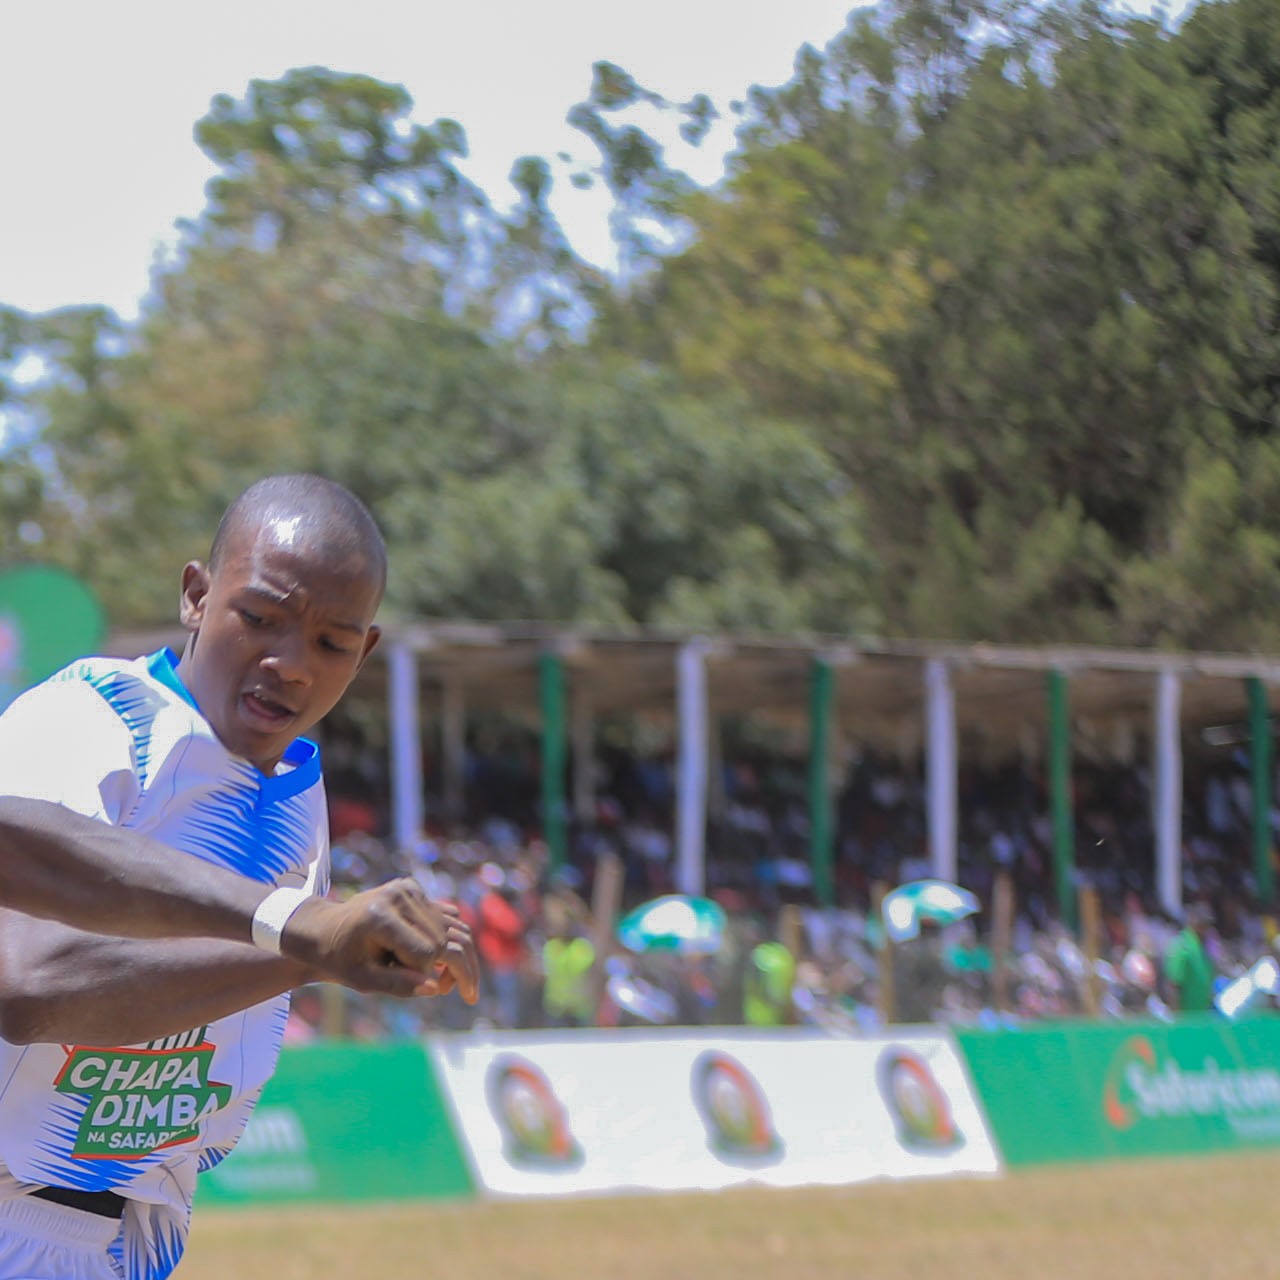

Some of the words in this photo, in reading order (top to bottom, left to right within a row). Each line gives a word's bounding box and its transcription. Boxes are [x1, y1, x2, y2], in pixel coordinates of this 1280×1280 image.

[70, 1057, 202, 1091] CHAPA
[91, 1093, 218, 1127] DIMBA
[87, 1132, 105, 1143] NA
